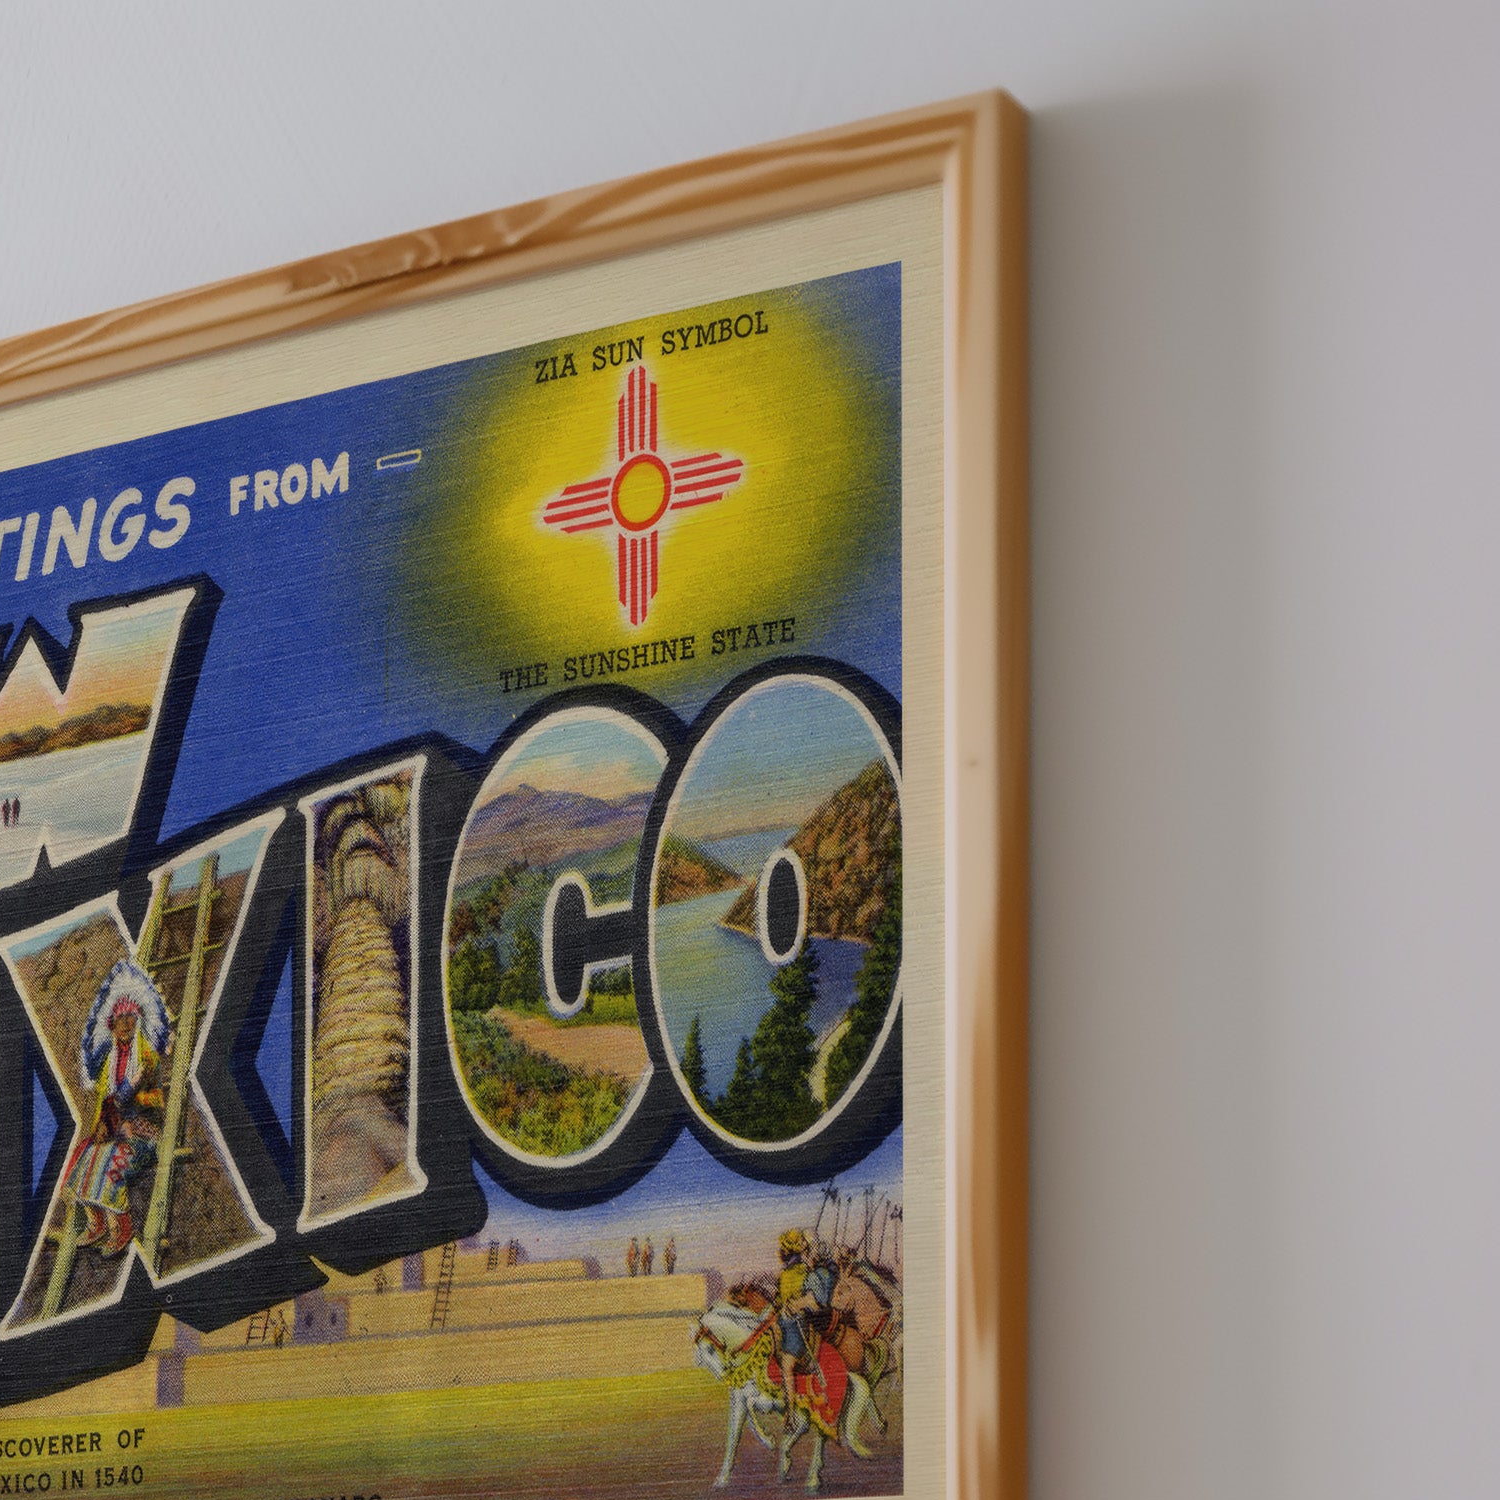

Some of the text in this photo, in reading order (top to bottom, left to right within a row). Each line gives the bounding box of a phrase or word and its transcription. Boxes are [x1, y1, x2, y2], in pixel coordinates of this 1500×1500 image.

[535, 310, 769, 384] ZIA SUN SYMBOL
[228, 451, 350, 517] FROM
[500, 617, 797, 693] THE SUNSHINE STATE
[117, 1427, 146, 1449] OF
[61, 1469, 84, 1490] IN
[94, 1464, 144, 1489] 1540
